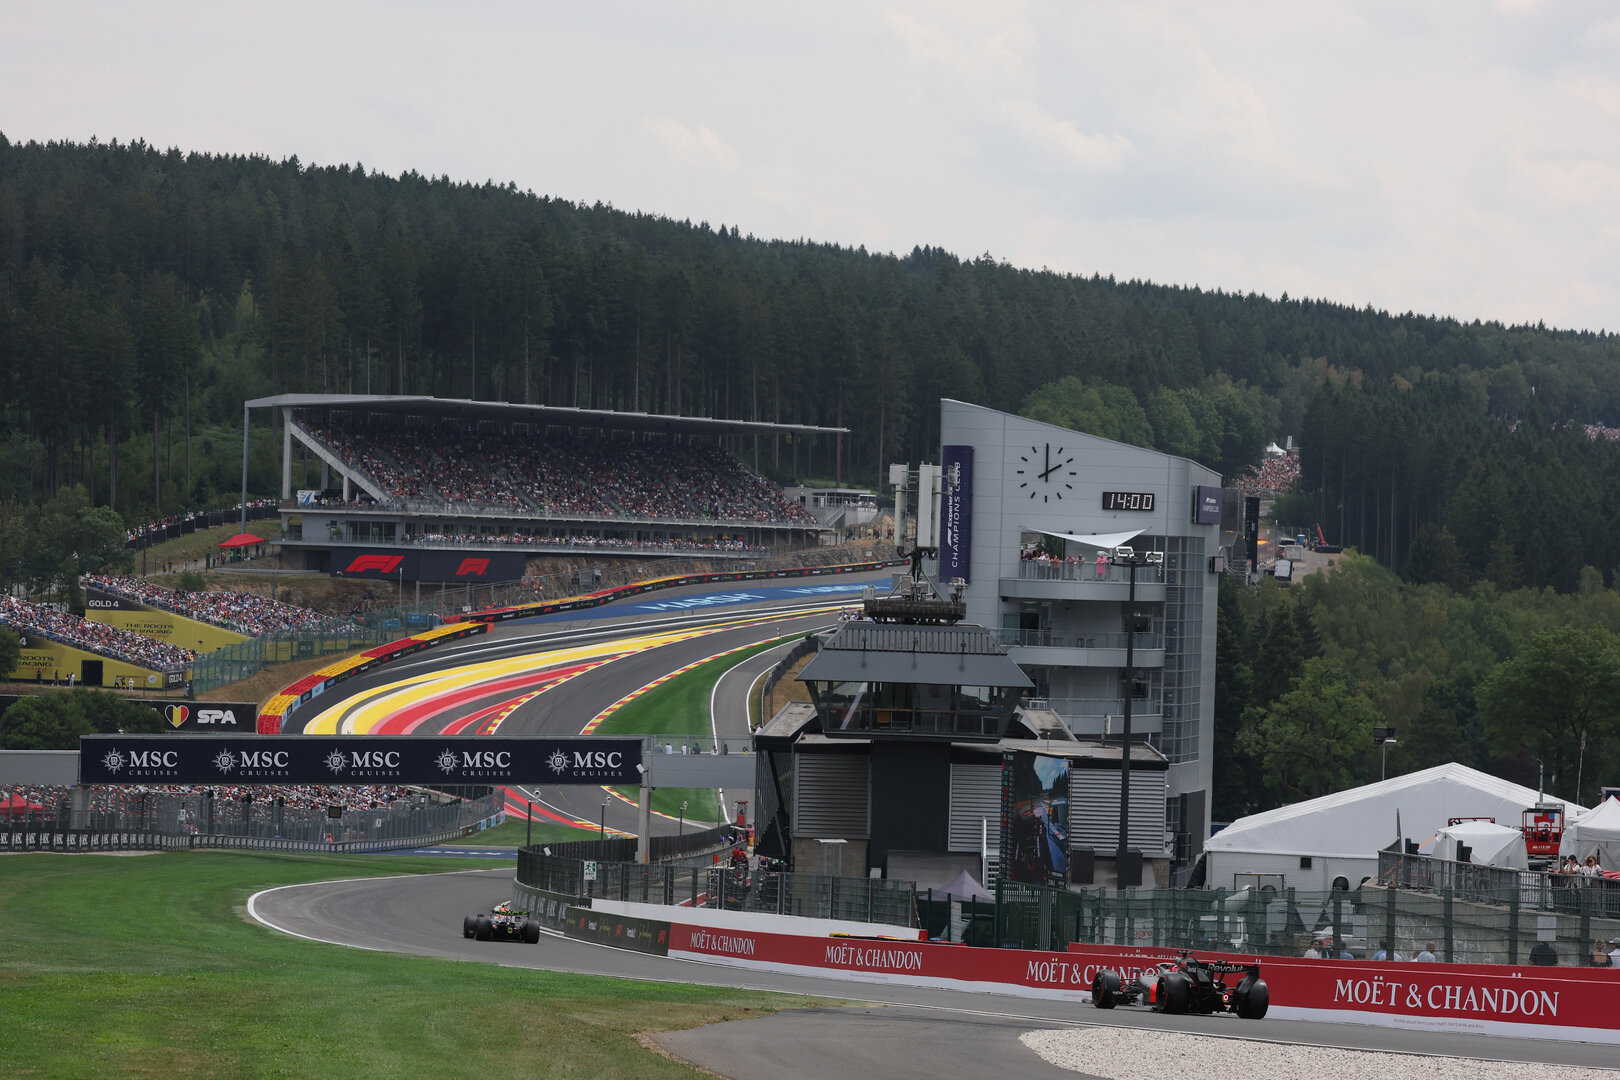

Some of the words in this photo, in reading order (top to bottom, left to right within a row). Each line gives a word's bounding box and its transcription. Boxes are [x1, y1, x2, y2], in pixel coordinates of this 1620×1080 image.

[1110, 493, 1153, 510] 14:00
[951, 496, 961, 568] CHAMPIONS
[88, 599, 112, 608] GOLD
[112, 600, 119, 608] 4
[168, 673, 179, 684] GOLD
[179, 672, 183, 682] 4
[196, 709, 237, 724] SPA
[129, 751, 178, 768] MSC
[240, 751, 289, 768] MSC
[351, 751, 401, 768] MSC
[462, 751, 512, 768] MSC
[573, 751, 623, 768] MSC
[689, 930, 711, 950] MOËT
[711, 937, 717, 950] &
[717, 937, 755, 955] CHANDON
[824, 942, 856, 964] MOËT
[856, 949, 864, 966] &
[865, 949, 923, 970] CHANDON
[1025, 957, 1070, 983] MOËT
[1070, 964, 1083, 984] &
[1207, 963, 1244, 973] Revolut
[1333, 975, 1403, 1006] MOËT
[1405, 983, 1423, 1008] &
[1427, 984, 1560, 1017] CHANDON
